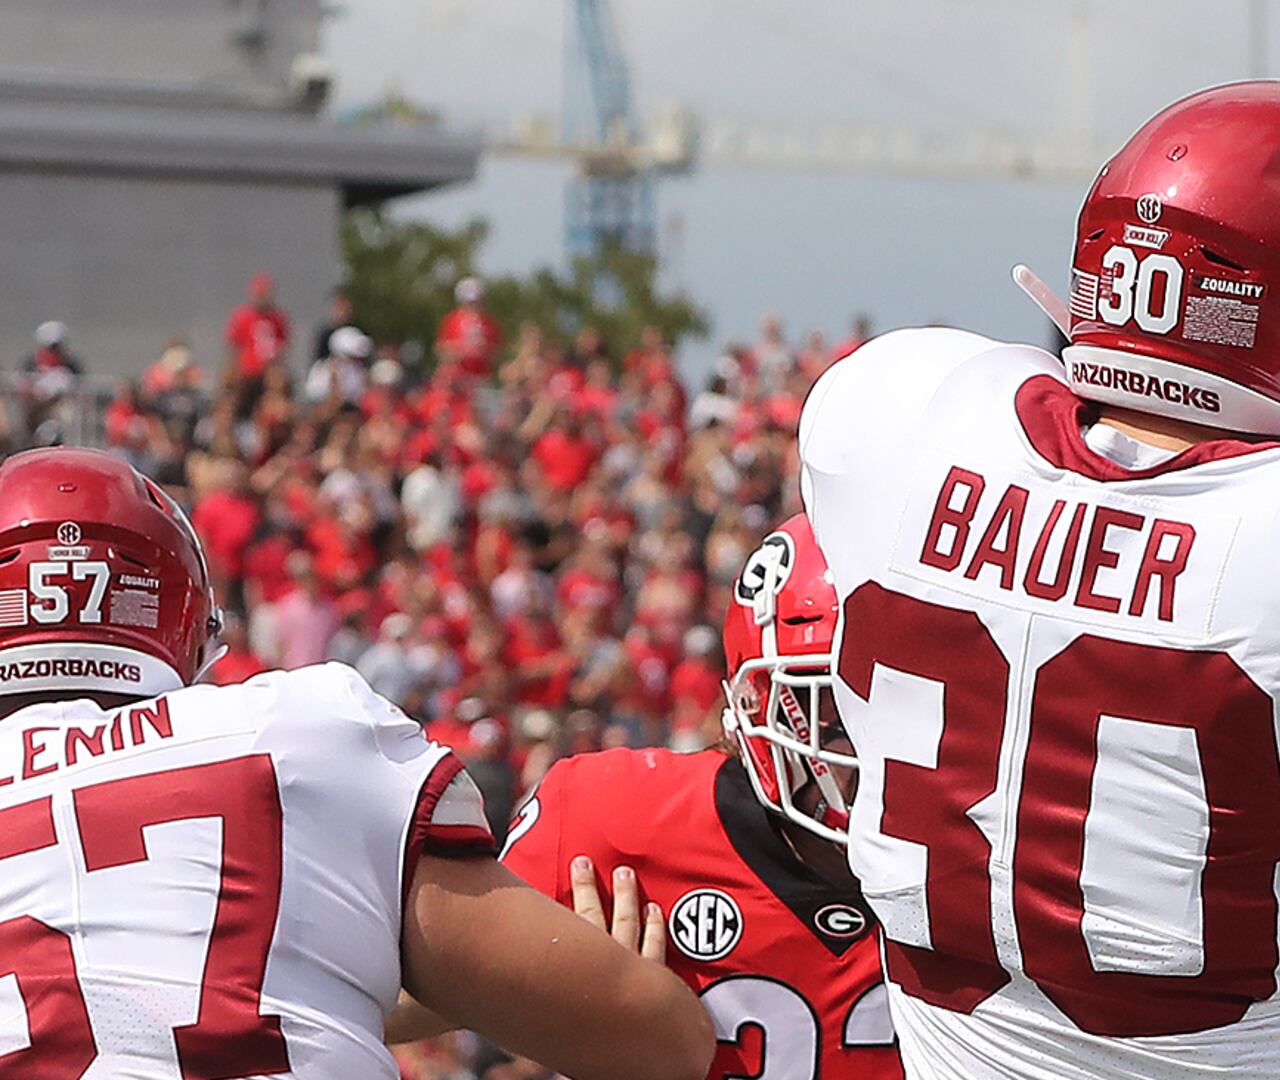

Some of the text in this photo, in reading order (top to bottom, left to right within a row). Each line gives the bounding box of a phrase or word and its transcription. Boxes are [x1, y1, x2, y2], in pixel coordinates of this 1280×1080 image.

[1099, 245, 1184, 335] 30
[1201, 277, 1264, 298] EQUALITY
[1072, 362, 1221, 413] RAZORBACKS
[919, 465, 1197, 622] BAUER
[29, 561, 110, 625] 57
[0, 696, 174, 787] ENIN
[671, 892, 741, 958] SEC
[815, 904, 865, 938] G
